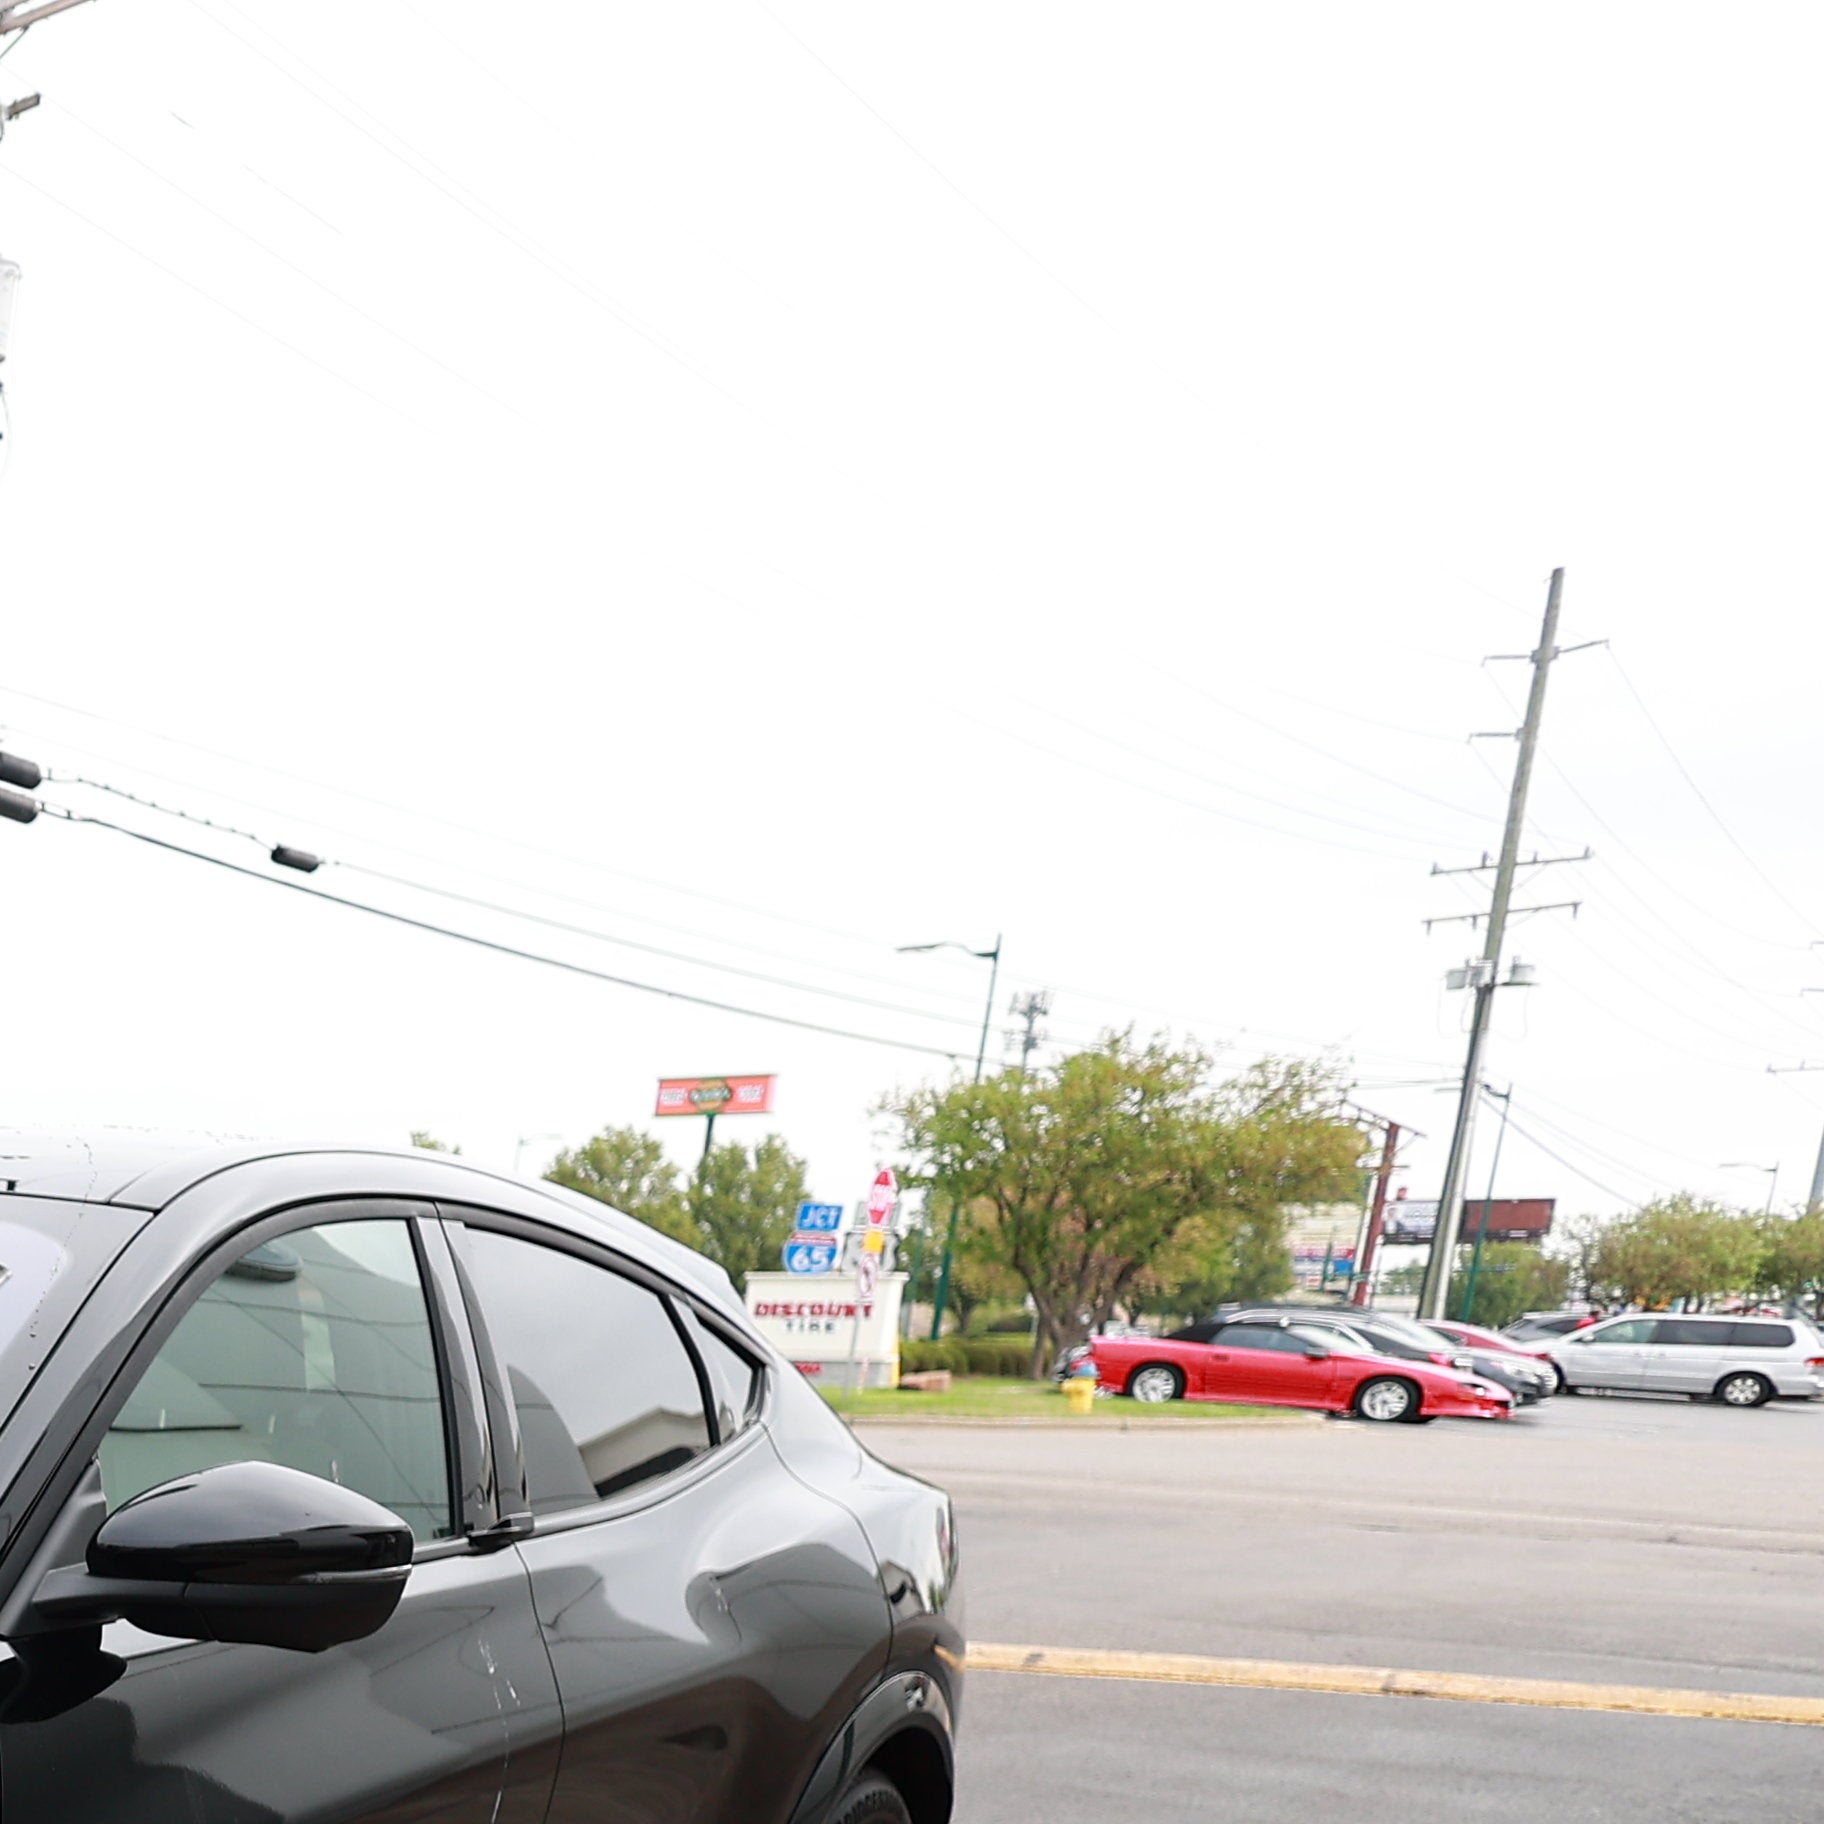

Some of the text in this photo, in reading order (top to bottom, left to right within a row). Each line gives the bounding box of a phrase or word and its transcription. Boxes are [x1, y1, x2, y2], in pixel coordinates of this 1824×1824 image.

[804, 1206, 838, 1226] JCT
[791, 1246, 830, 1271] 65
[755, 1303, 872, 1317] DISCOUNT
[786, 1322, 834, 1332] TIRE
